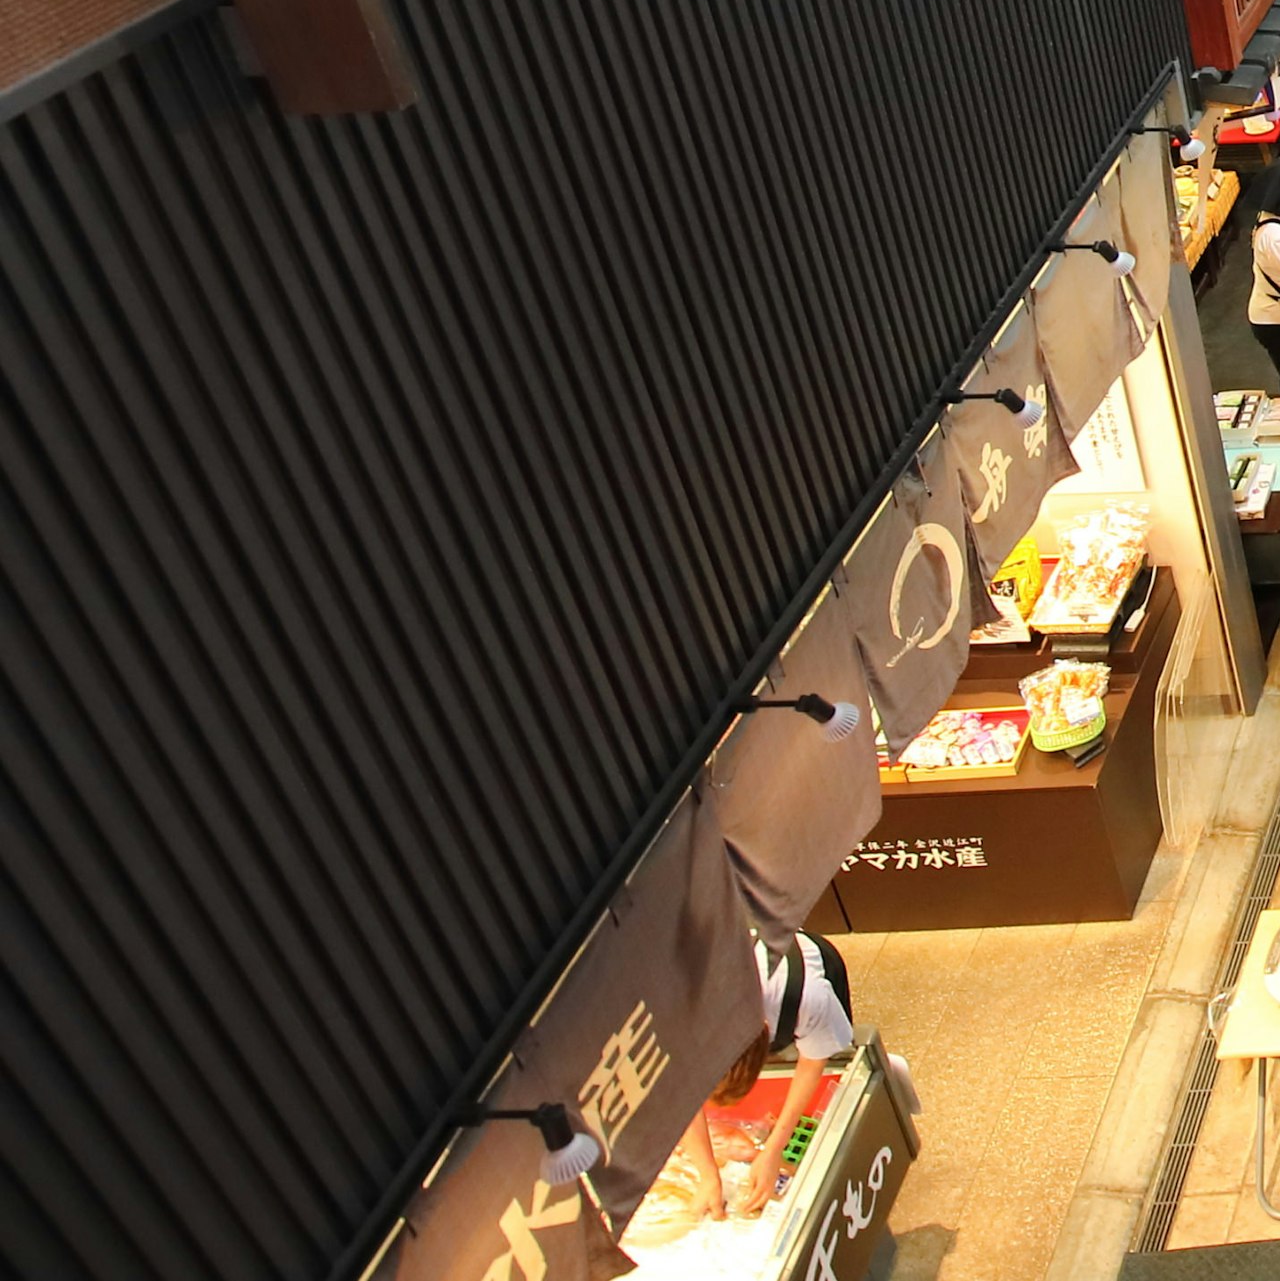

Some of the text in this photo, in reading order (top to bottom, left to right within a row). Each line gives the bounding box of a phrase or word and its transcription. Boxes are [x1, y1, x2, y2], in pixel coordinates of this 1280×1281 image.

[914, 836, 984, 850] 金沢近江町
